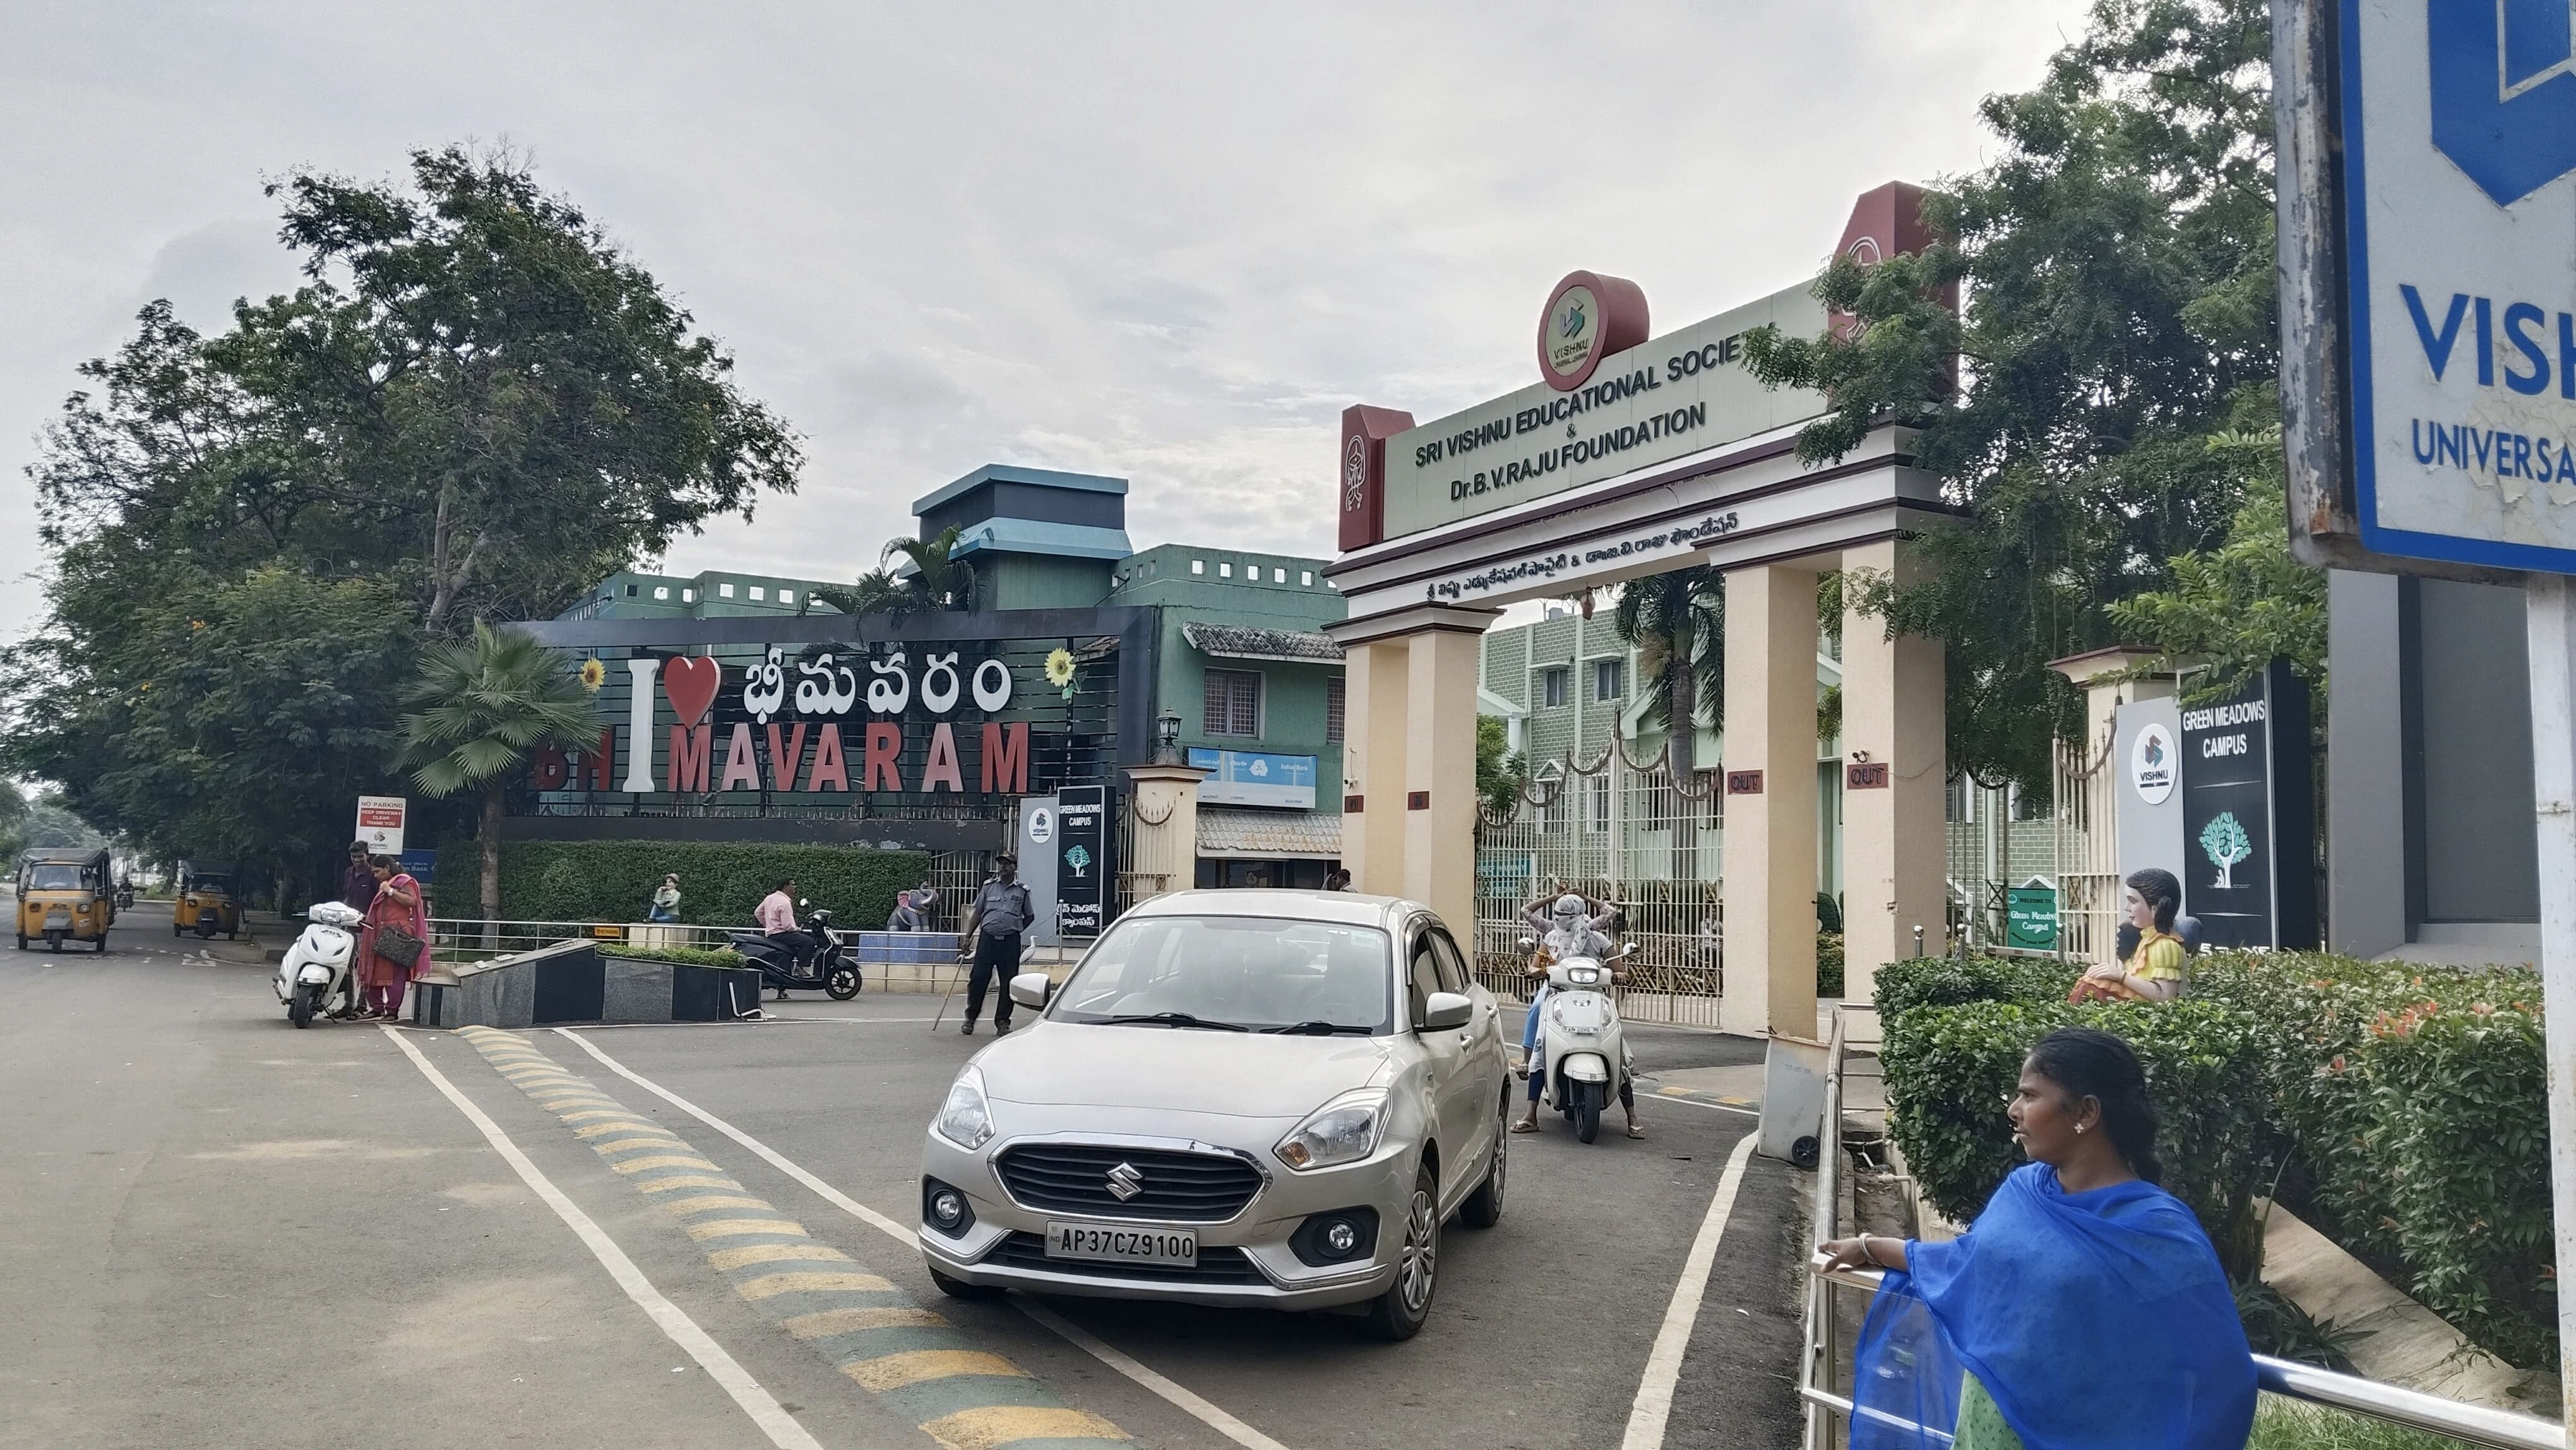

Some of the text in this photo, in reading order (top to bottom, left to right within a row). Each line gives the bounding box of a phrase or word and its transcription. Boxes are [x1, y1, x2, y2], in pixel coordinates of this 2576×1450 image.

[1554, 339, 1589, 360] VISHNU
[1416, 331, 1748, 468] SRI VISHNU EDUCATIONAL SOCIE
[1561, 402, 1706, 469] FOUNDATION
[1566, 424, 1577, 438] &
[1571, 555, 1582, 567] &
[743, 647, 1013, 724] భీమవరం
[2183, 700, 2265, 731] GREEN MEADOWS
[2203, 734, 2247, 758] CAMPUS
[1731, 775, 1760, 790] OUT
[1851, 768, 1883, 785] OUT
[2139, 769, 2168, 781] VISHNU
[1059, 804, 1101, 814] GREEN MEADOWS
[1069, 817, 1091, 827] CAMPUS
[2011, 911, 2030, 920] Green
[2022, 921, 2049, 934] Campus
[1061, 1228, 1193, 1258] AP37CZ9100
